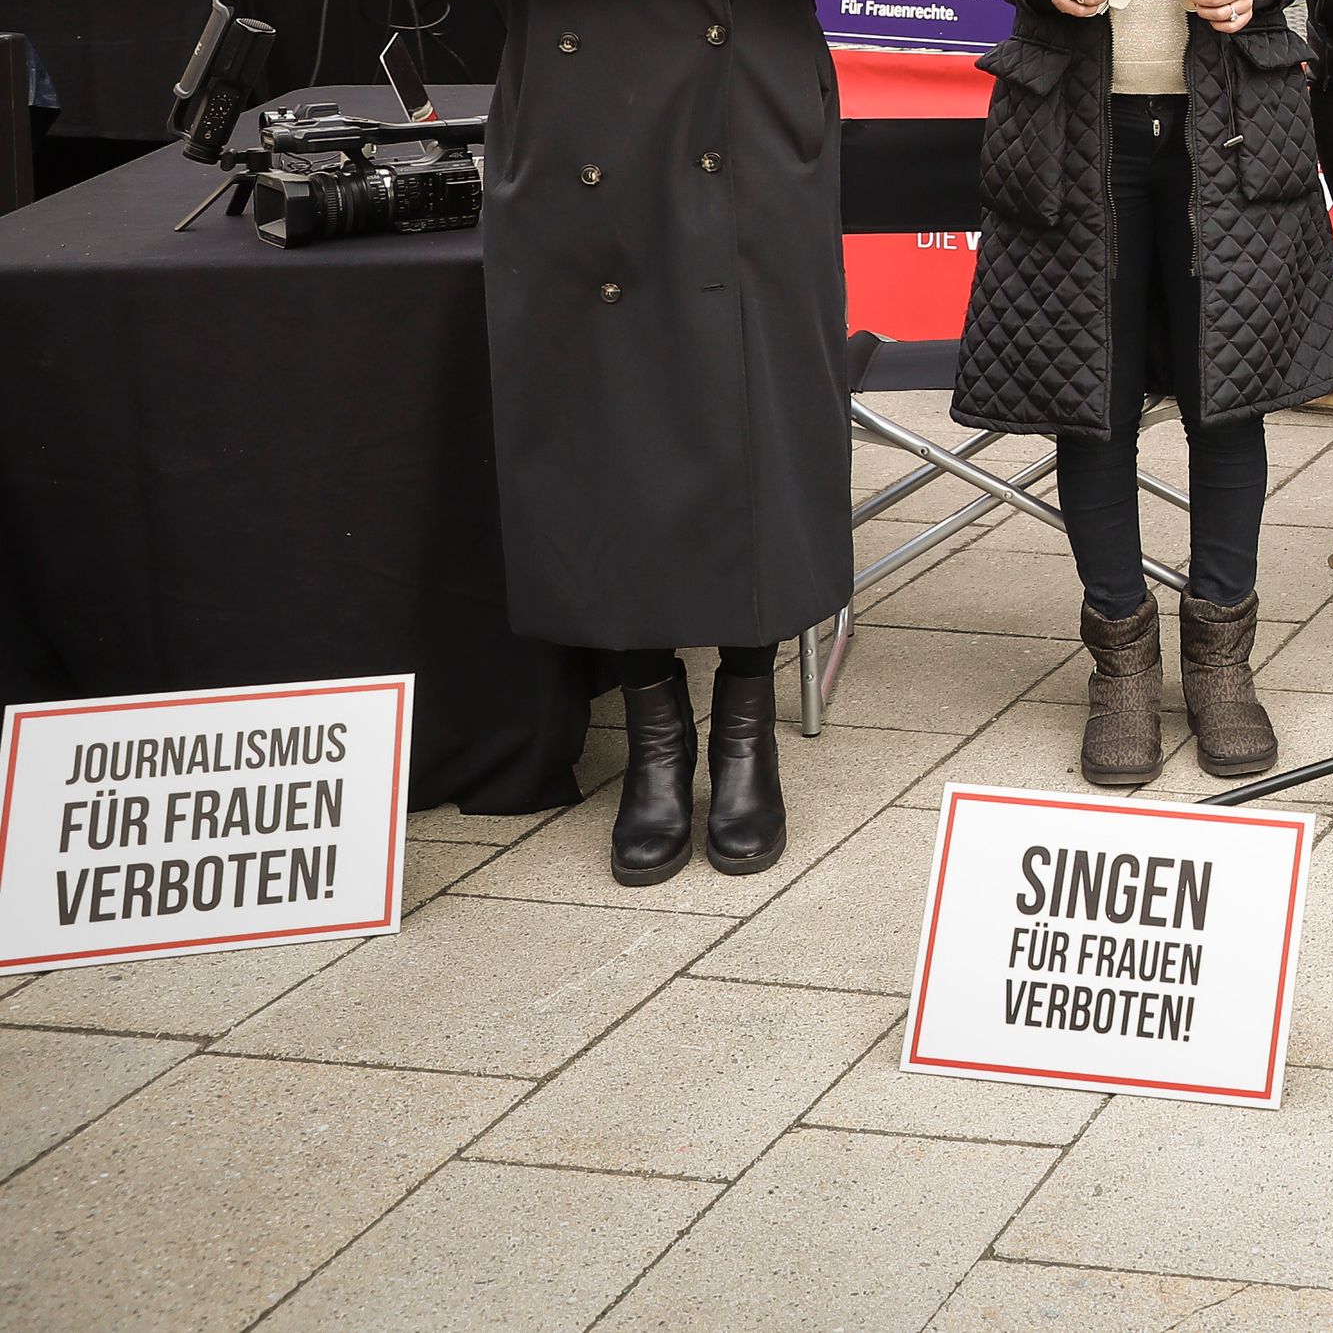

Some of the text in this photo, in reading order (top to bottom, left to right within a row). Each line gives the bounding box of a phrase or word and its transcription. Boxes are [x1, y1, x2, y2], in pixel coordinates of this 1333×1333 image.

[865, 0, 958, 21] Frauenrechte.
[65, 722, 348, 786] JOURNALISMUS
[59, 778, 344, 854] FÜR FRAUEN
[56, 844, 338, 927] VERBOTEN!
[1016, 845, 1213, 932] SINGEN
[1008, 921, 1203, 986] FÜR FRAUEN
[1005, 978, 1195, 1042] VERBOTEN!
